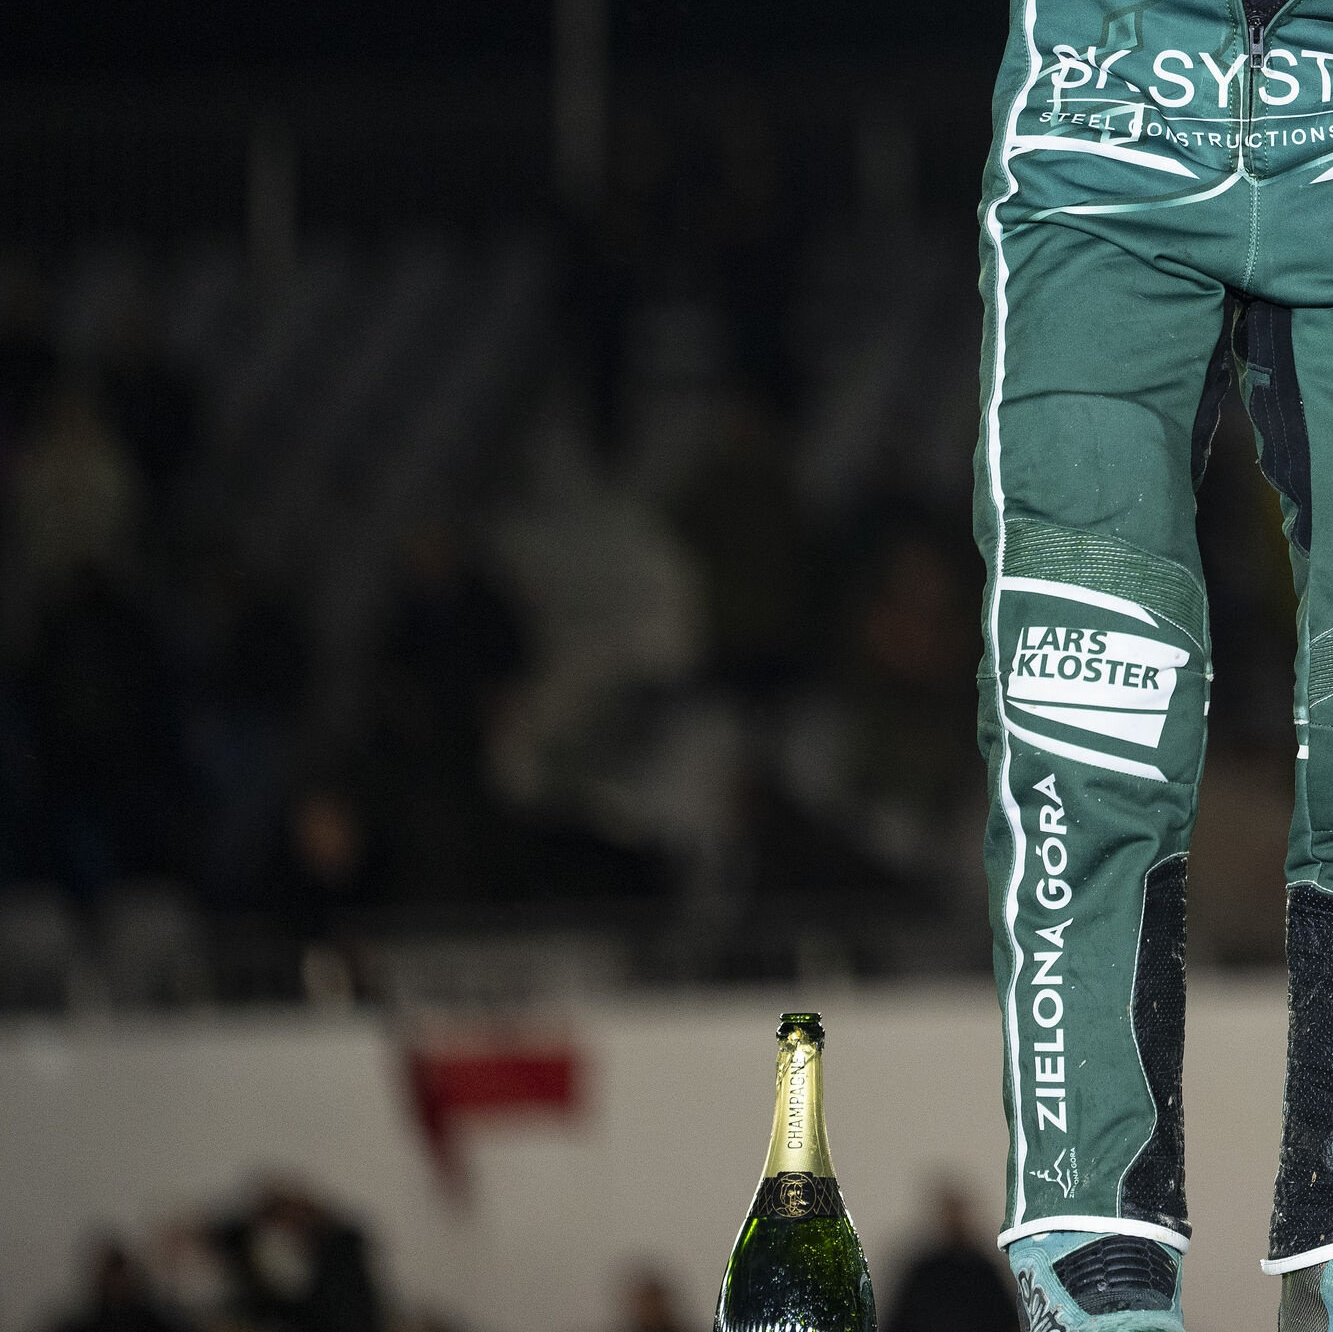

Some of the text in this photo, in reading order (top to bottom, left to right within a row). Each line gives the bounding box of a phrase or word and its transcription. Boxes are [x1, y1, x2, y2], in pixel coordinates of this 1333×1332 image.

[1040, 111, 1116, 131] STEEL
[1021, 627, 1108, 655] LARS
[1016, 653, 1160, 690] KLOSTER
[1032, 773, 1072, 911] GÓRA
[1031, 917, 1074, 1134] ZIELONA
[1068, 1169, 1079, 1199] ZIEONA
